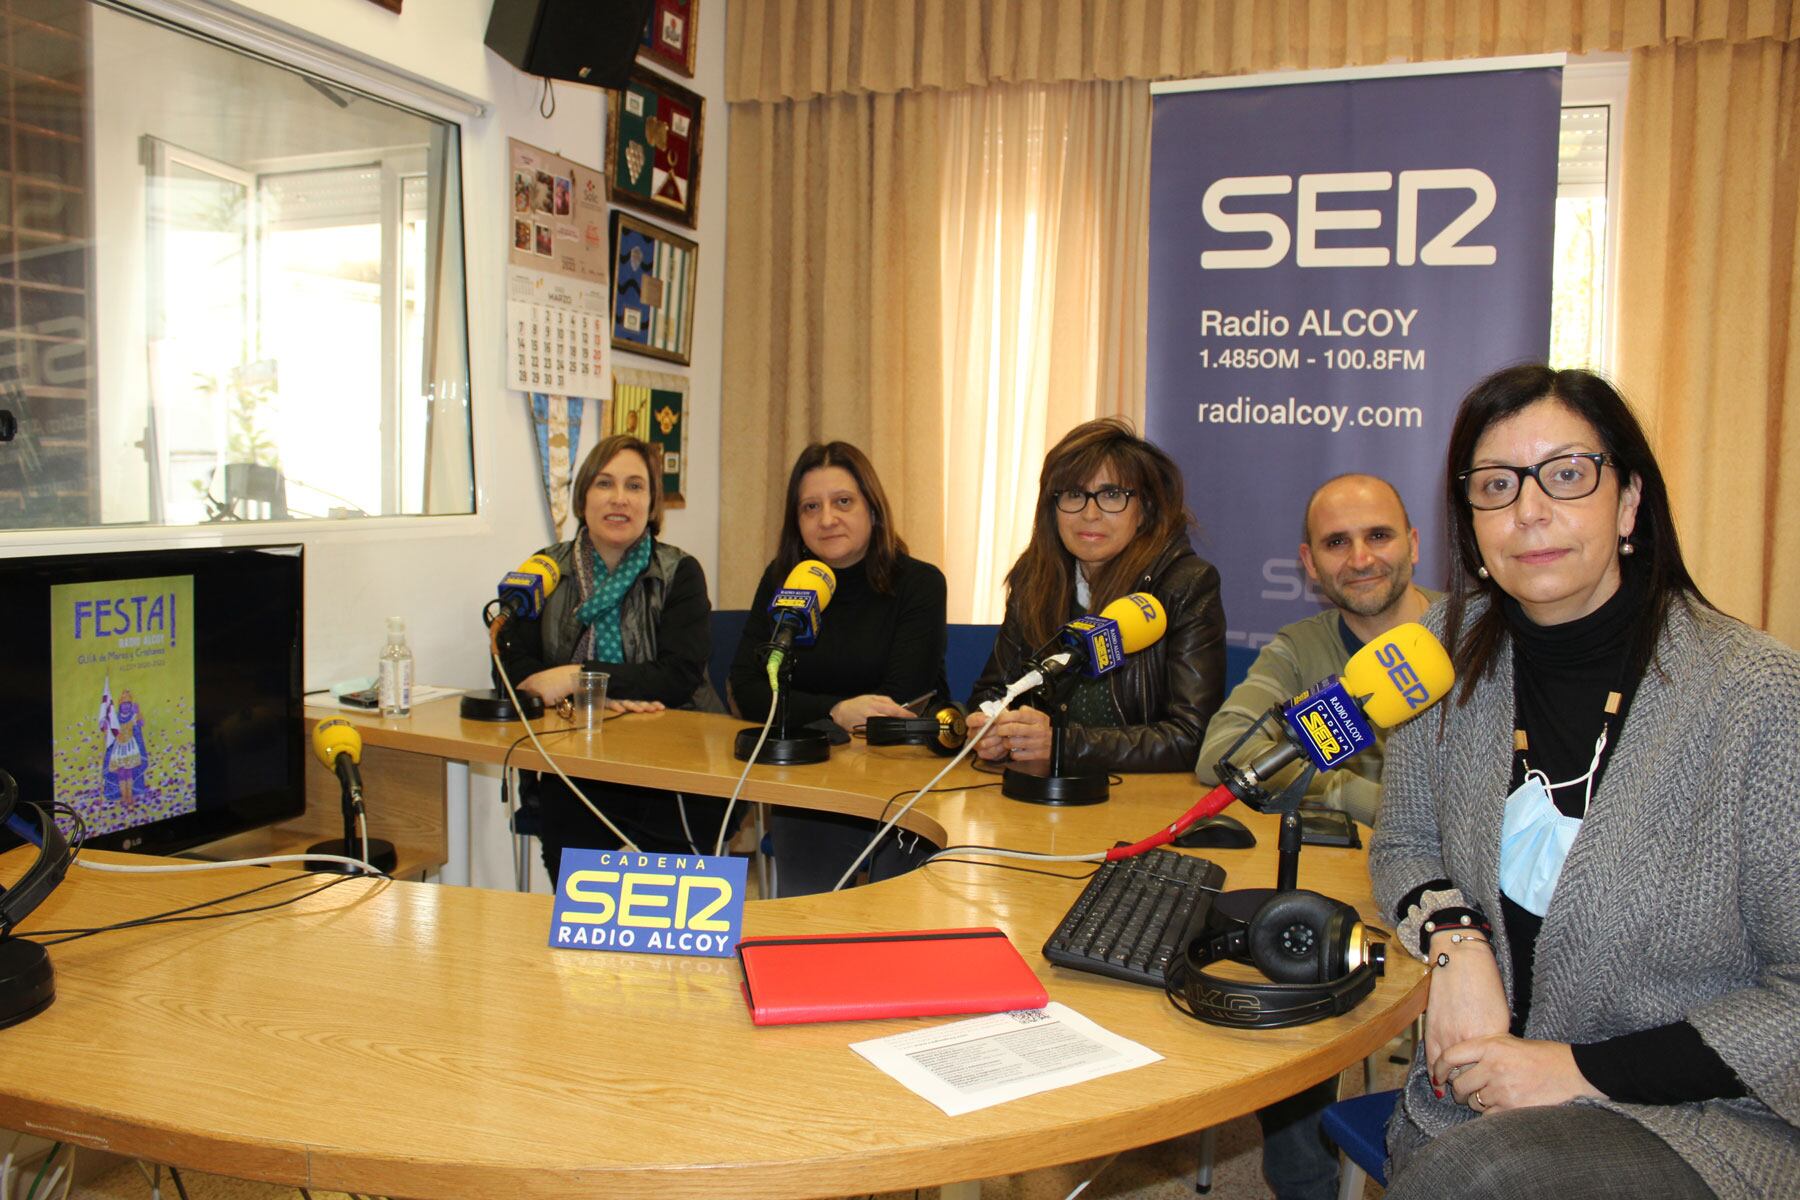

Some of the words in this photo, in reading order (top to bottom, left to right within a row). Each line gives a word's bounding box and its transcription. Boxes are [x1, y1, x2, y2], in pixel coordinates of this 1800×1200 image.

[1201, 168, 1497, 269] SER
[1201, 310, 1290, 337] Radio
[1298, 309, 1418, 337] ALCOY
[1324, 350, 1425, 370] 100.8FM
[1198, 397, 1423, 432] radioalcoy.com
[74, 593, 176, 647] FESTA!
[1374, 643, 1430, 709] SER
[1300, 711, 1340, 761] SER
[1316, 704, 1349, 751] CADENA
[1329, 696, 1349, 720] RADIO
[1344, 717, 1365, 743] ALCOY
[600, 854, 706, 870] CADENA
[560, 869, 733, 932] SER
[558, 926, 635, 947] RADIO
[647, 931, 729, 953] ALCOY
